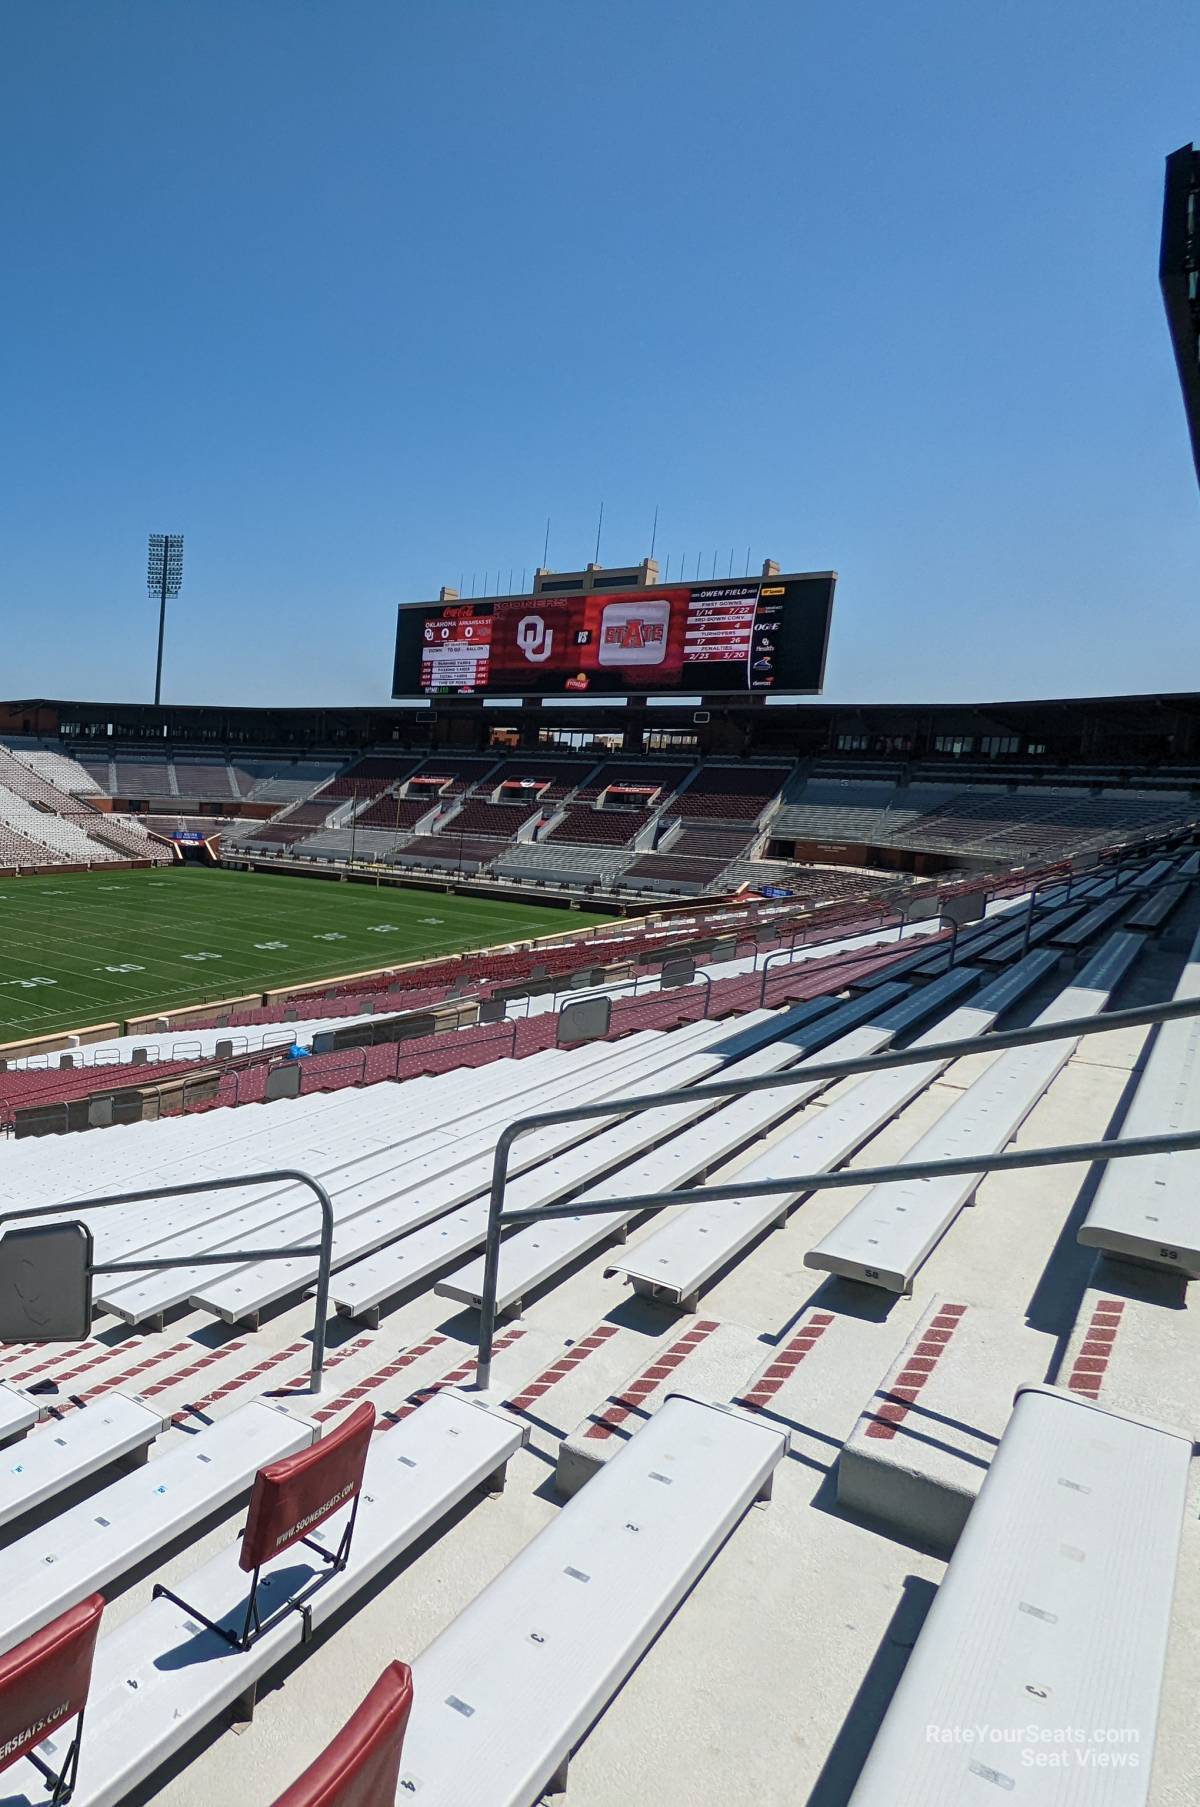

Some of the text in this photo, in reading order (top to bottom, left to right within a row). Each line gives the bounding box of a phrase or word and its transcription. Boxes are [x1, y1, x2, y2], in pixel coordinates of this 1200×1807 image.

[700, 590, 725, 598] OWEN
[725, 588, 747, 596] FIELD
[441, 628, 449, 639] 0
[465, 627, 473, 638] 0
[578, 632, 589, 643] VS
[606, 619, 664, 649] STATE
[181, 952, 223, 961] 50
[104, 964, 146, 973] 40
[9, 976, 58, 988] 30
[1159, 1249, 1178, 1259] 59
[276, 1482, 354, 1546] WWW.SOONERSEATS.COM
[530, 1633, 544, 1644] 3
[1025, 1685, 1047, 1698] 3
